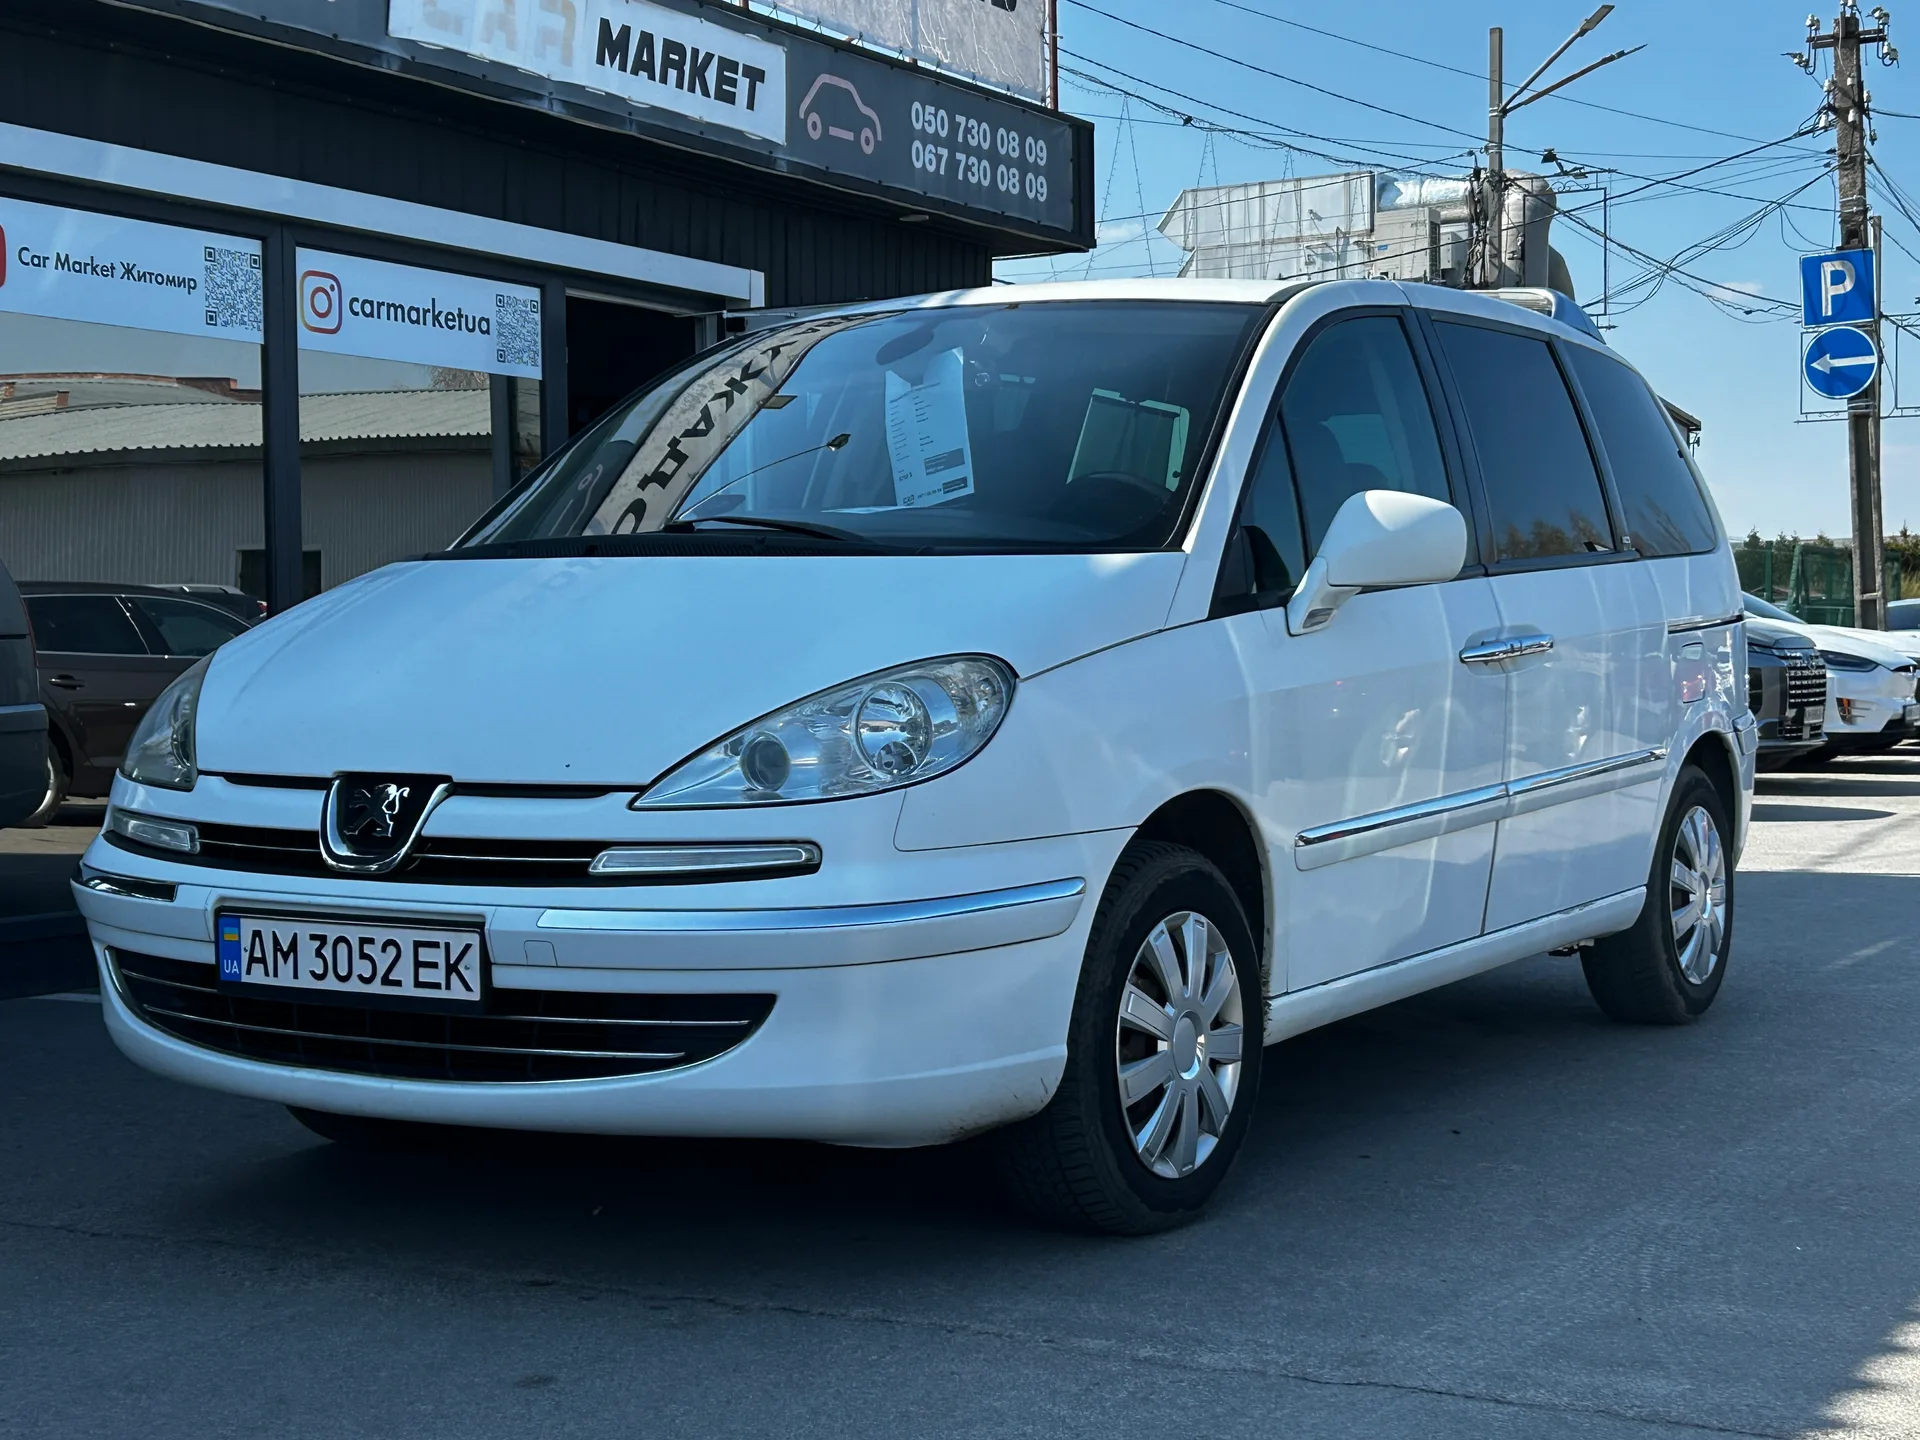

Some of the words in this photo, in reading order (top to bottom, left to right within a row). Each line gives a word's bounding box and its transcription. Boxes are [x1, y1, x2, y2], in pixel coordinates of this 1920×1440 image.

[596, 17, 766, 112] MARKET
[911, 101, 949, 138] 050
[955, 114, 991, 150] 730
[996, 127, 1020, 159] 08
[1025, 136, 1047, 166] 09
[911, 140, 949, 175] 067
[955, 152, 991, 187] 730
[996, 164, 1020, 195] 08
[1025, 172, 1048, 202] 09
[17, 246, 50, 268] Car
[54, 252, 116, 279] Market
[119, 261, 198, 296] Житомир
[1820, 260, 1856, 317] P
[348, 297, 491, 336] carmarketua
[223, 959, 240, 975] UA
[245, 929, 299, 980] AM
[308, 933, 403, 988] 3052
[412, 939, 475, 993] EK
